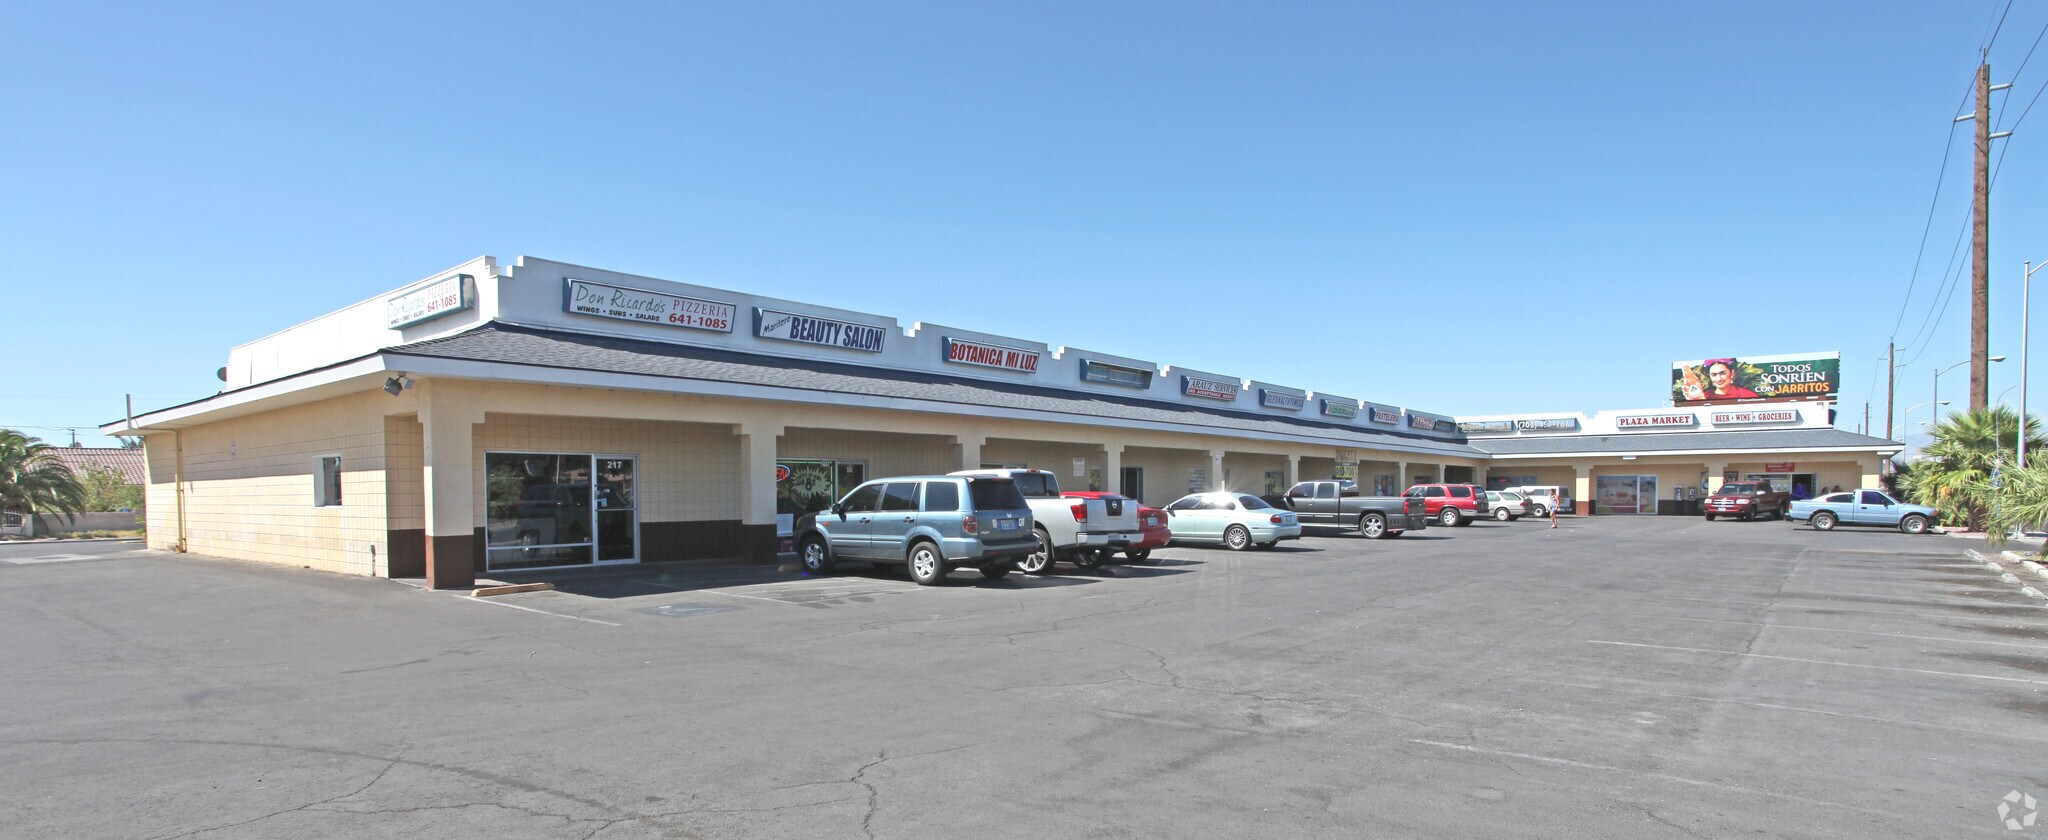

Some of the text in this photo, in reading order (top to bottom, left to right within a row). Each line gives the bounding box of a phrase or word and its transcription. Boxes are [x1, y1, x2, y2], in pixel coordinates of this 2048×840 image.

[575, 284, 604, 304] Don
[427, 294, 457, 312] 641-1085
[673, 300, 728, 318] PIZZERIA
[577, 305, 660, 322] WINGS SUBS SALADS
[668, 313, 728, 330] 641-1085
[789, 316, 883, 351] BEAUTY SALON
[950, 342, 1038, 371] BOTANICA MI LUZ
[1771, 363, 1811, 373] TODOS
[1191, 379, 1239, 394] ARAUZ SERVICES
[1775, 382, 1830, 394] JARRITOS
[1620, 416, 1690, 426] PLAZA MARKET
[1758, 412, 1792, 421] GROCERIES
[607, 461, 622, 469] 217
